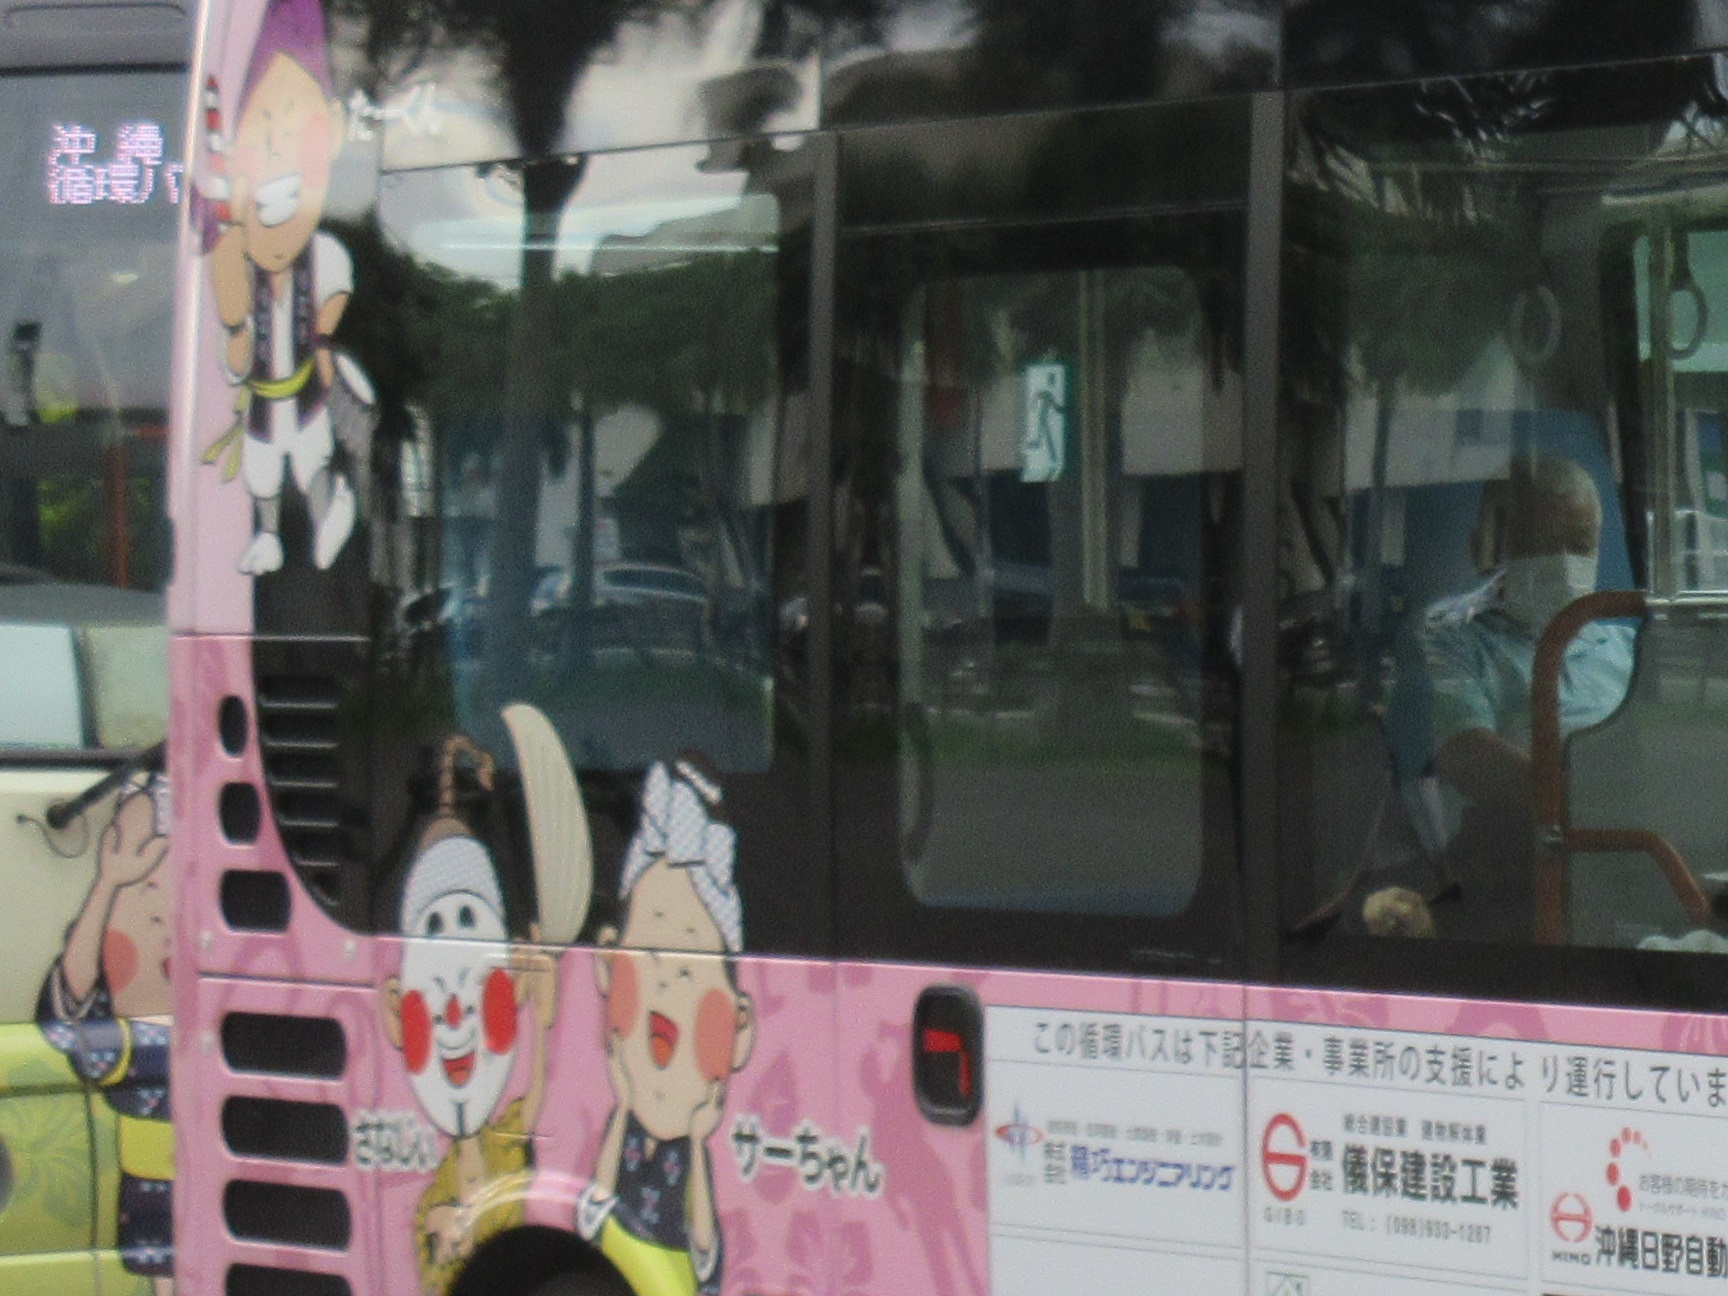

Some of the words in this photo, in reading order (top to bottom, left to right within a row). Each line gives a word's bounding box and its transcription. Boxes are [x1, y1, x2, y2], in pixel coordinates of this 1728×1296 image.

[48, 125, 164, 166] 沖縄
[732, 1115, 882, 1195] サーちゃん
[1551, 1251, 1592, 1266] HINO
